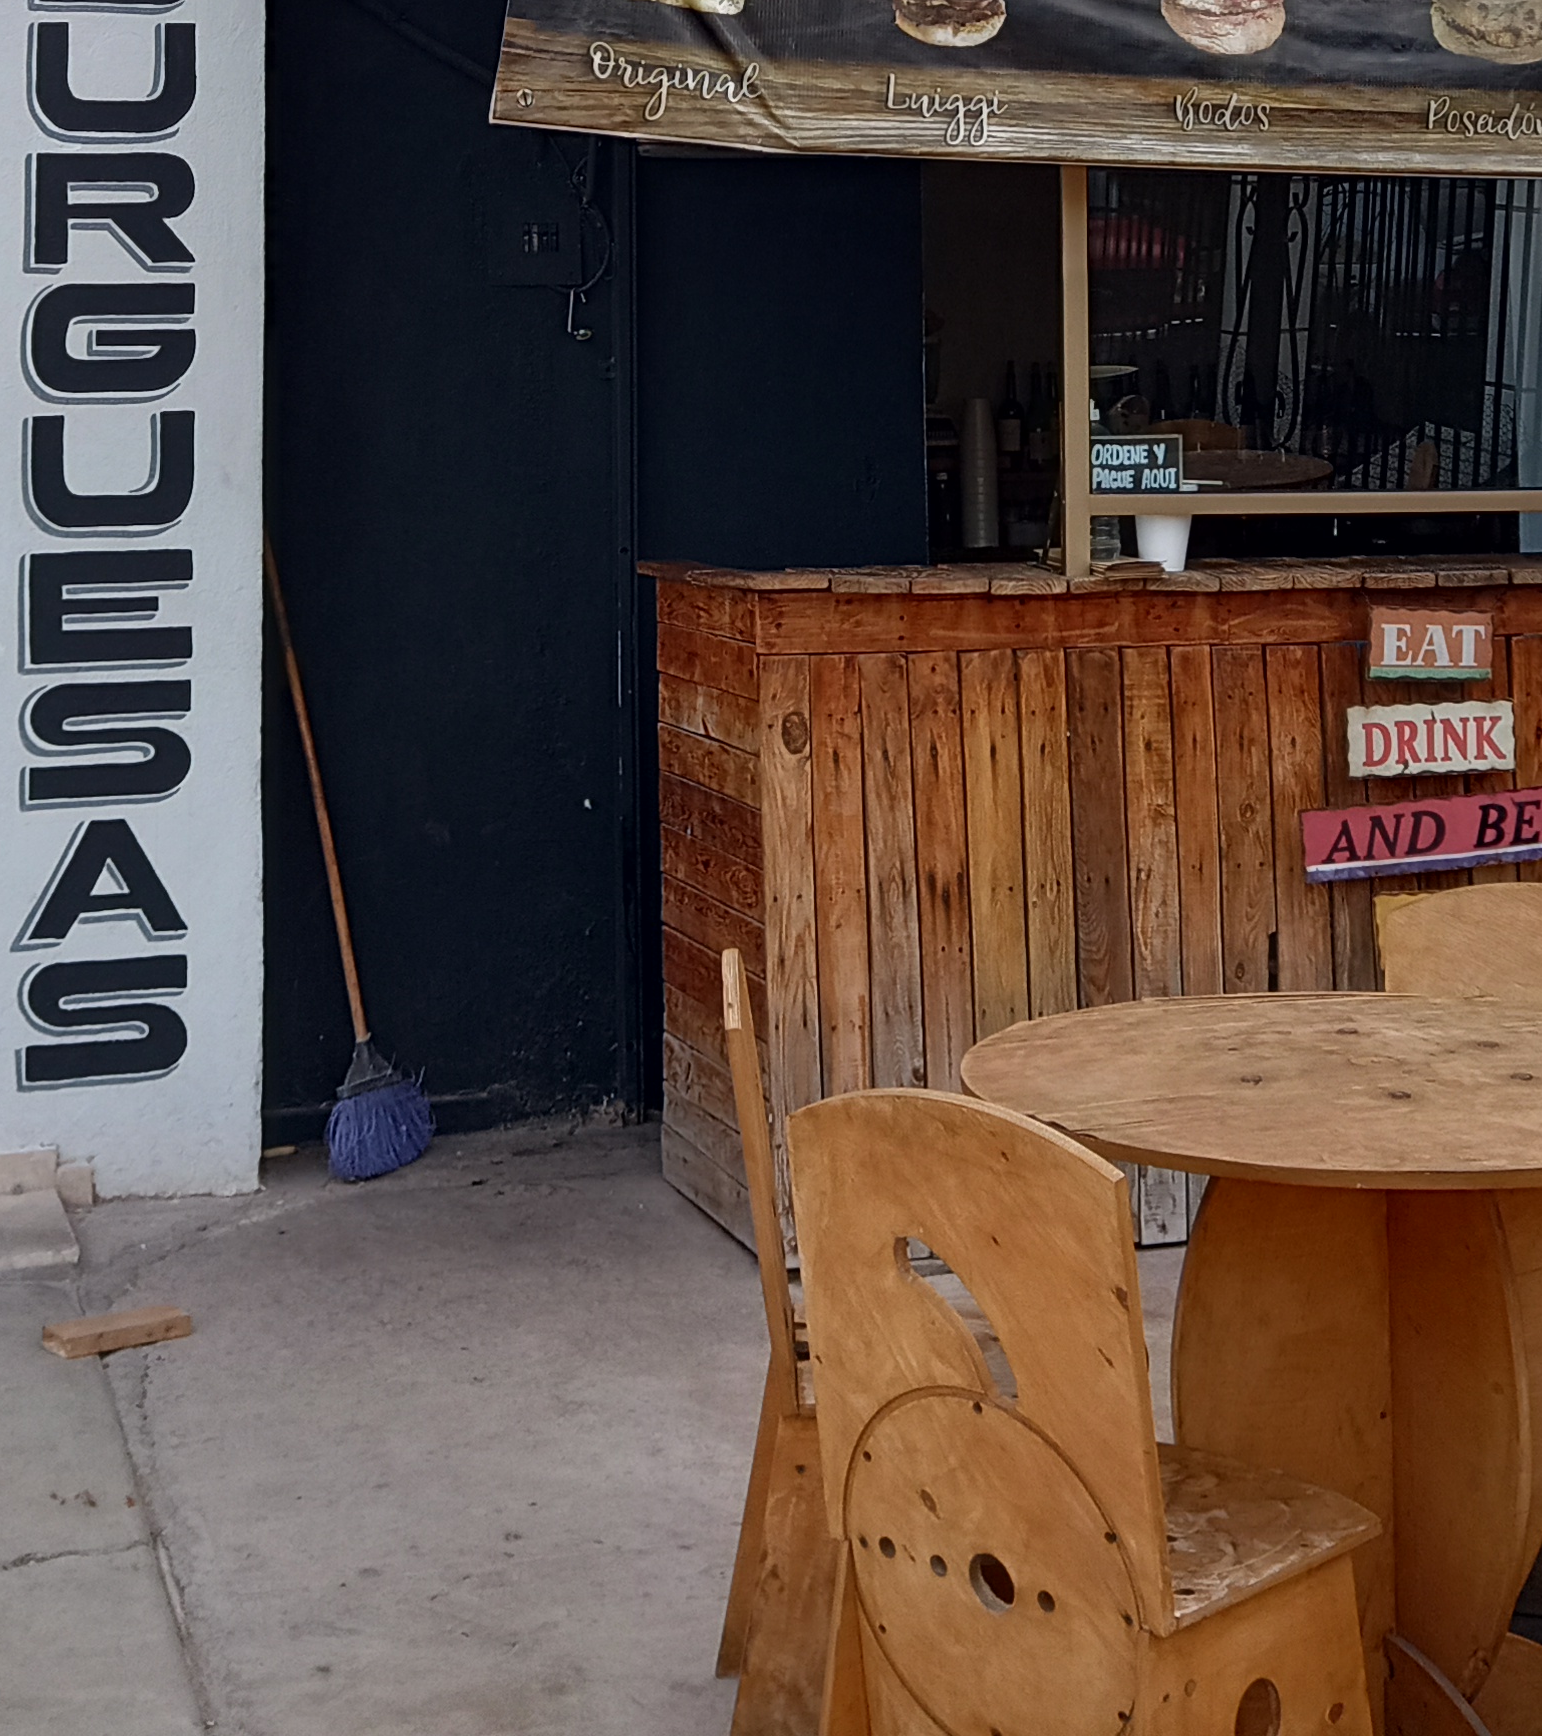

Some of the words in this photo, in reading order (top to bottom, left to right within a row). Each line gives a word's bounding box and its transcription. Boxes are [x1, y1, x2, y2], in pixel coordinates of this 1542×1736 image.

[589, 41, 763, 122] Original
[884, 72, 1008, 147] Luiggi
[1091, 443, 1150, 466] ORDENE
[1152, 442, 1166, 465] Y
[1091, 467, 1136, 490] PAGUE
[1141, 467, 1178, 490] AQUI
[1379, 623, 1486, 667] EAT
[1362, 715, 1508, 768] DRINK
[1321, 810, 1447, 865] AND
[1473, 800, 1542, 849] BE
